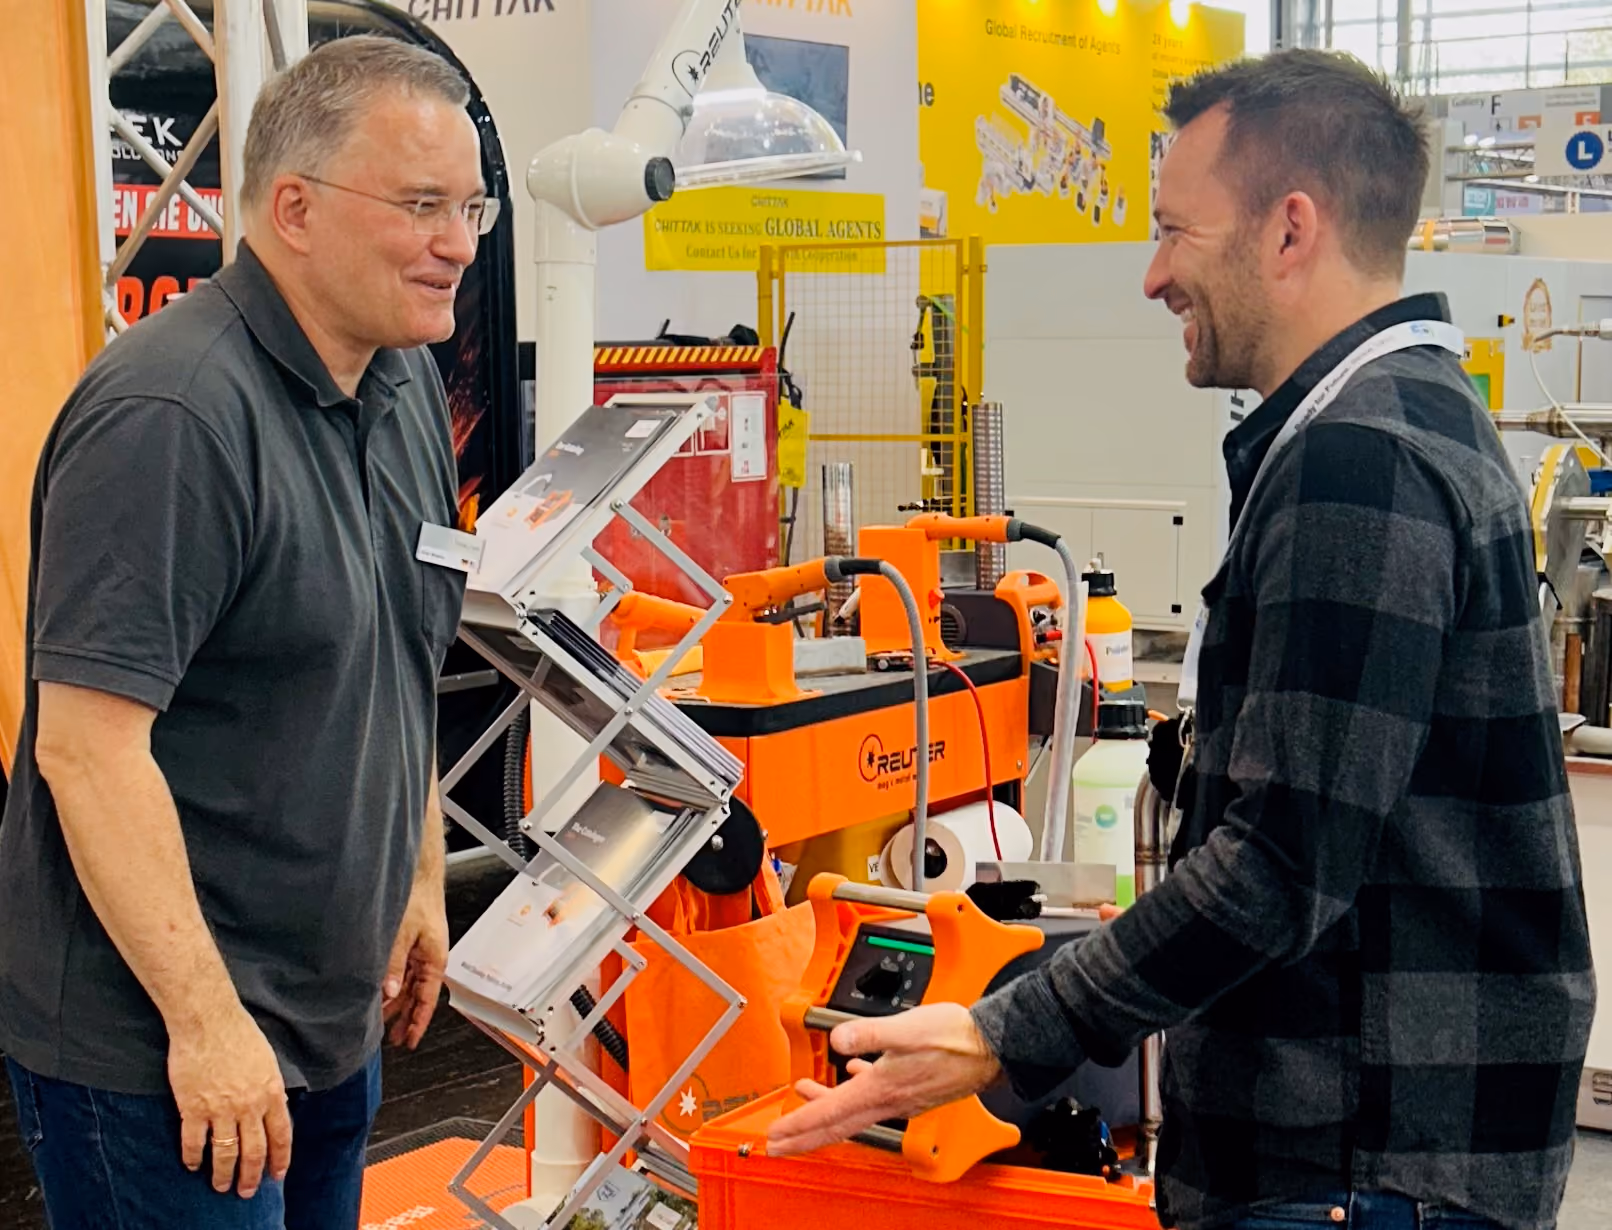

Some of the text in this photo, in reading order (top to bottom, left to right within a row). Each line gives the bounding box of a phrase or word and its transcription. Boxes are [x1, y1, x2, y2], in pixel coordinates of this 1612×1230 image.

[984, 18, 1121, 56] Global Recruitment of Agents
[1491, 95, 1502, 116] F
[1577, 140, 1594, 161] L
[655, 216, 882, 241] CHITTAK IS SEEKING GLOBAL AGENTS
[686, 244, 725, 260] Contact
[728, 246, 741, 260] Us
